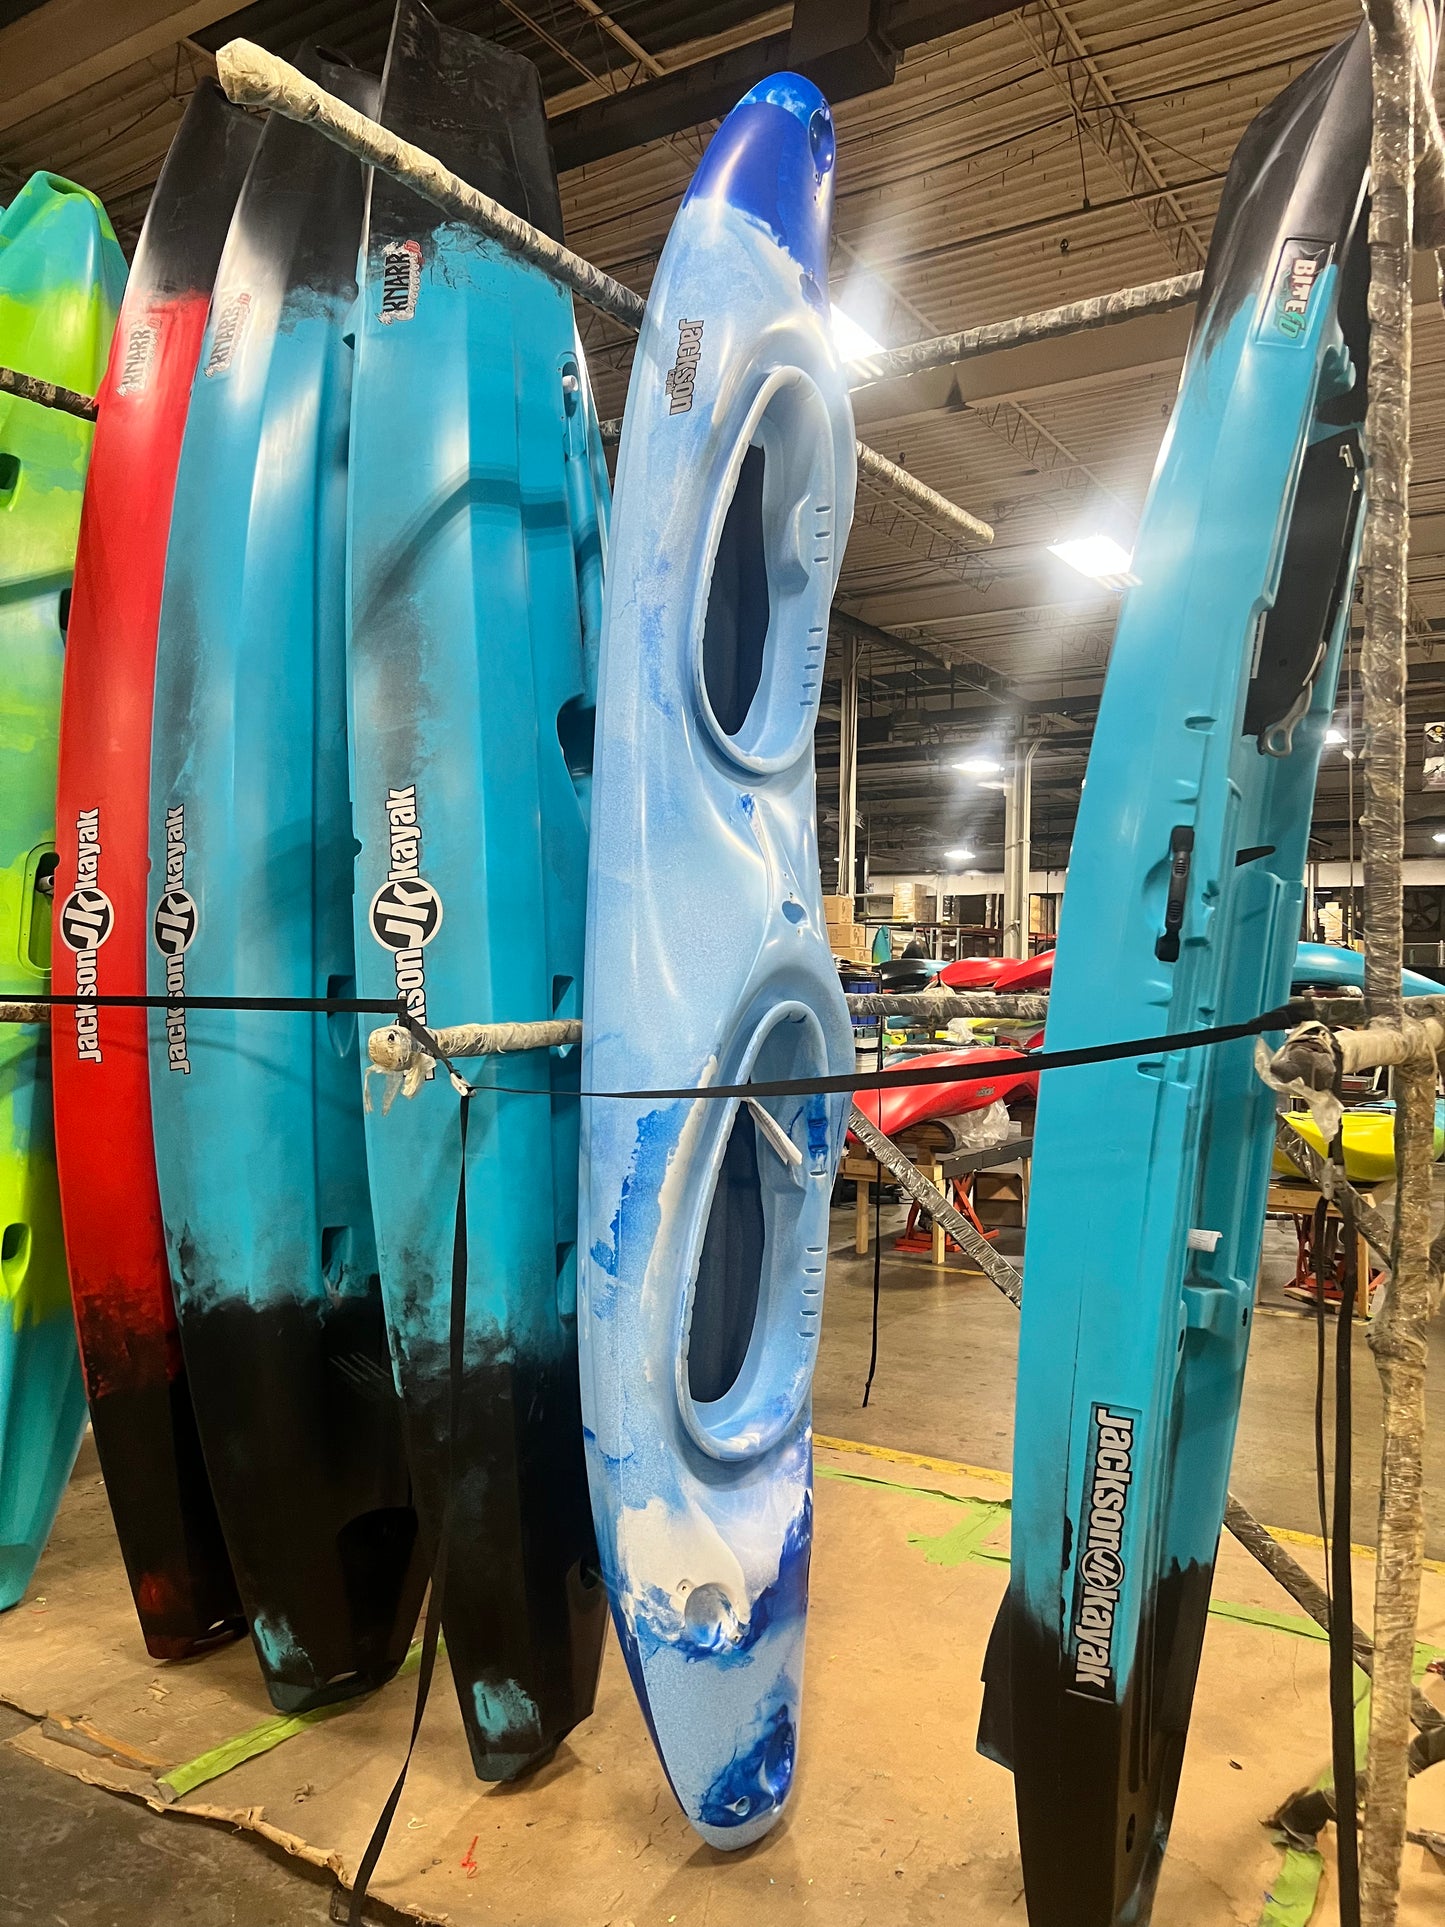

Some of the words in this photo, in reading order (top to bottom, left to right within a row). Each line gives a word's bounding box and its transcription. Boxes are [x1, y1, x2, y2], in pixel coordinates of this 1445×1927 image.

[382, 253, 411, 314] KNARR
[1284, 257, 1318, 315] BITE
[121, 329, 151, 385] KNARR
[208, 306, 240, 366] KNARR
[669, 318, 704, 416] Jackson
[74, 807, 101, 891] kayak
[164, 803, 186, 894] kayak
[385, 784, 422, 881] kayak
[1088, 1405, 1134, 1552] Jackson
[1075, 1584, 1119, 1690] kayak
